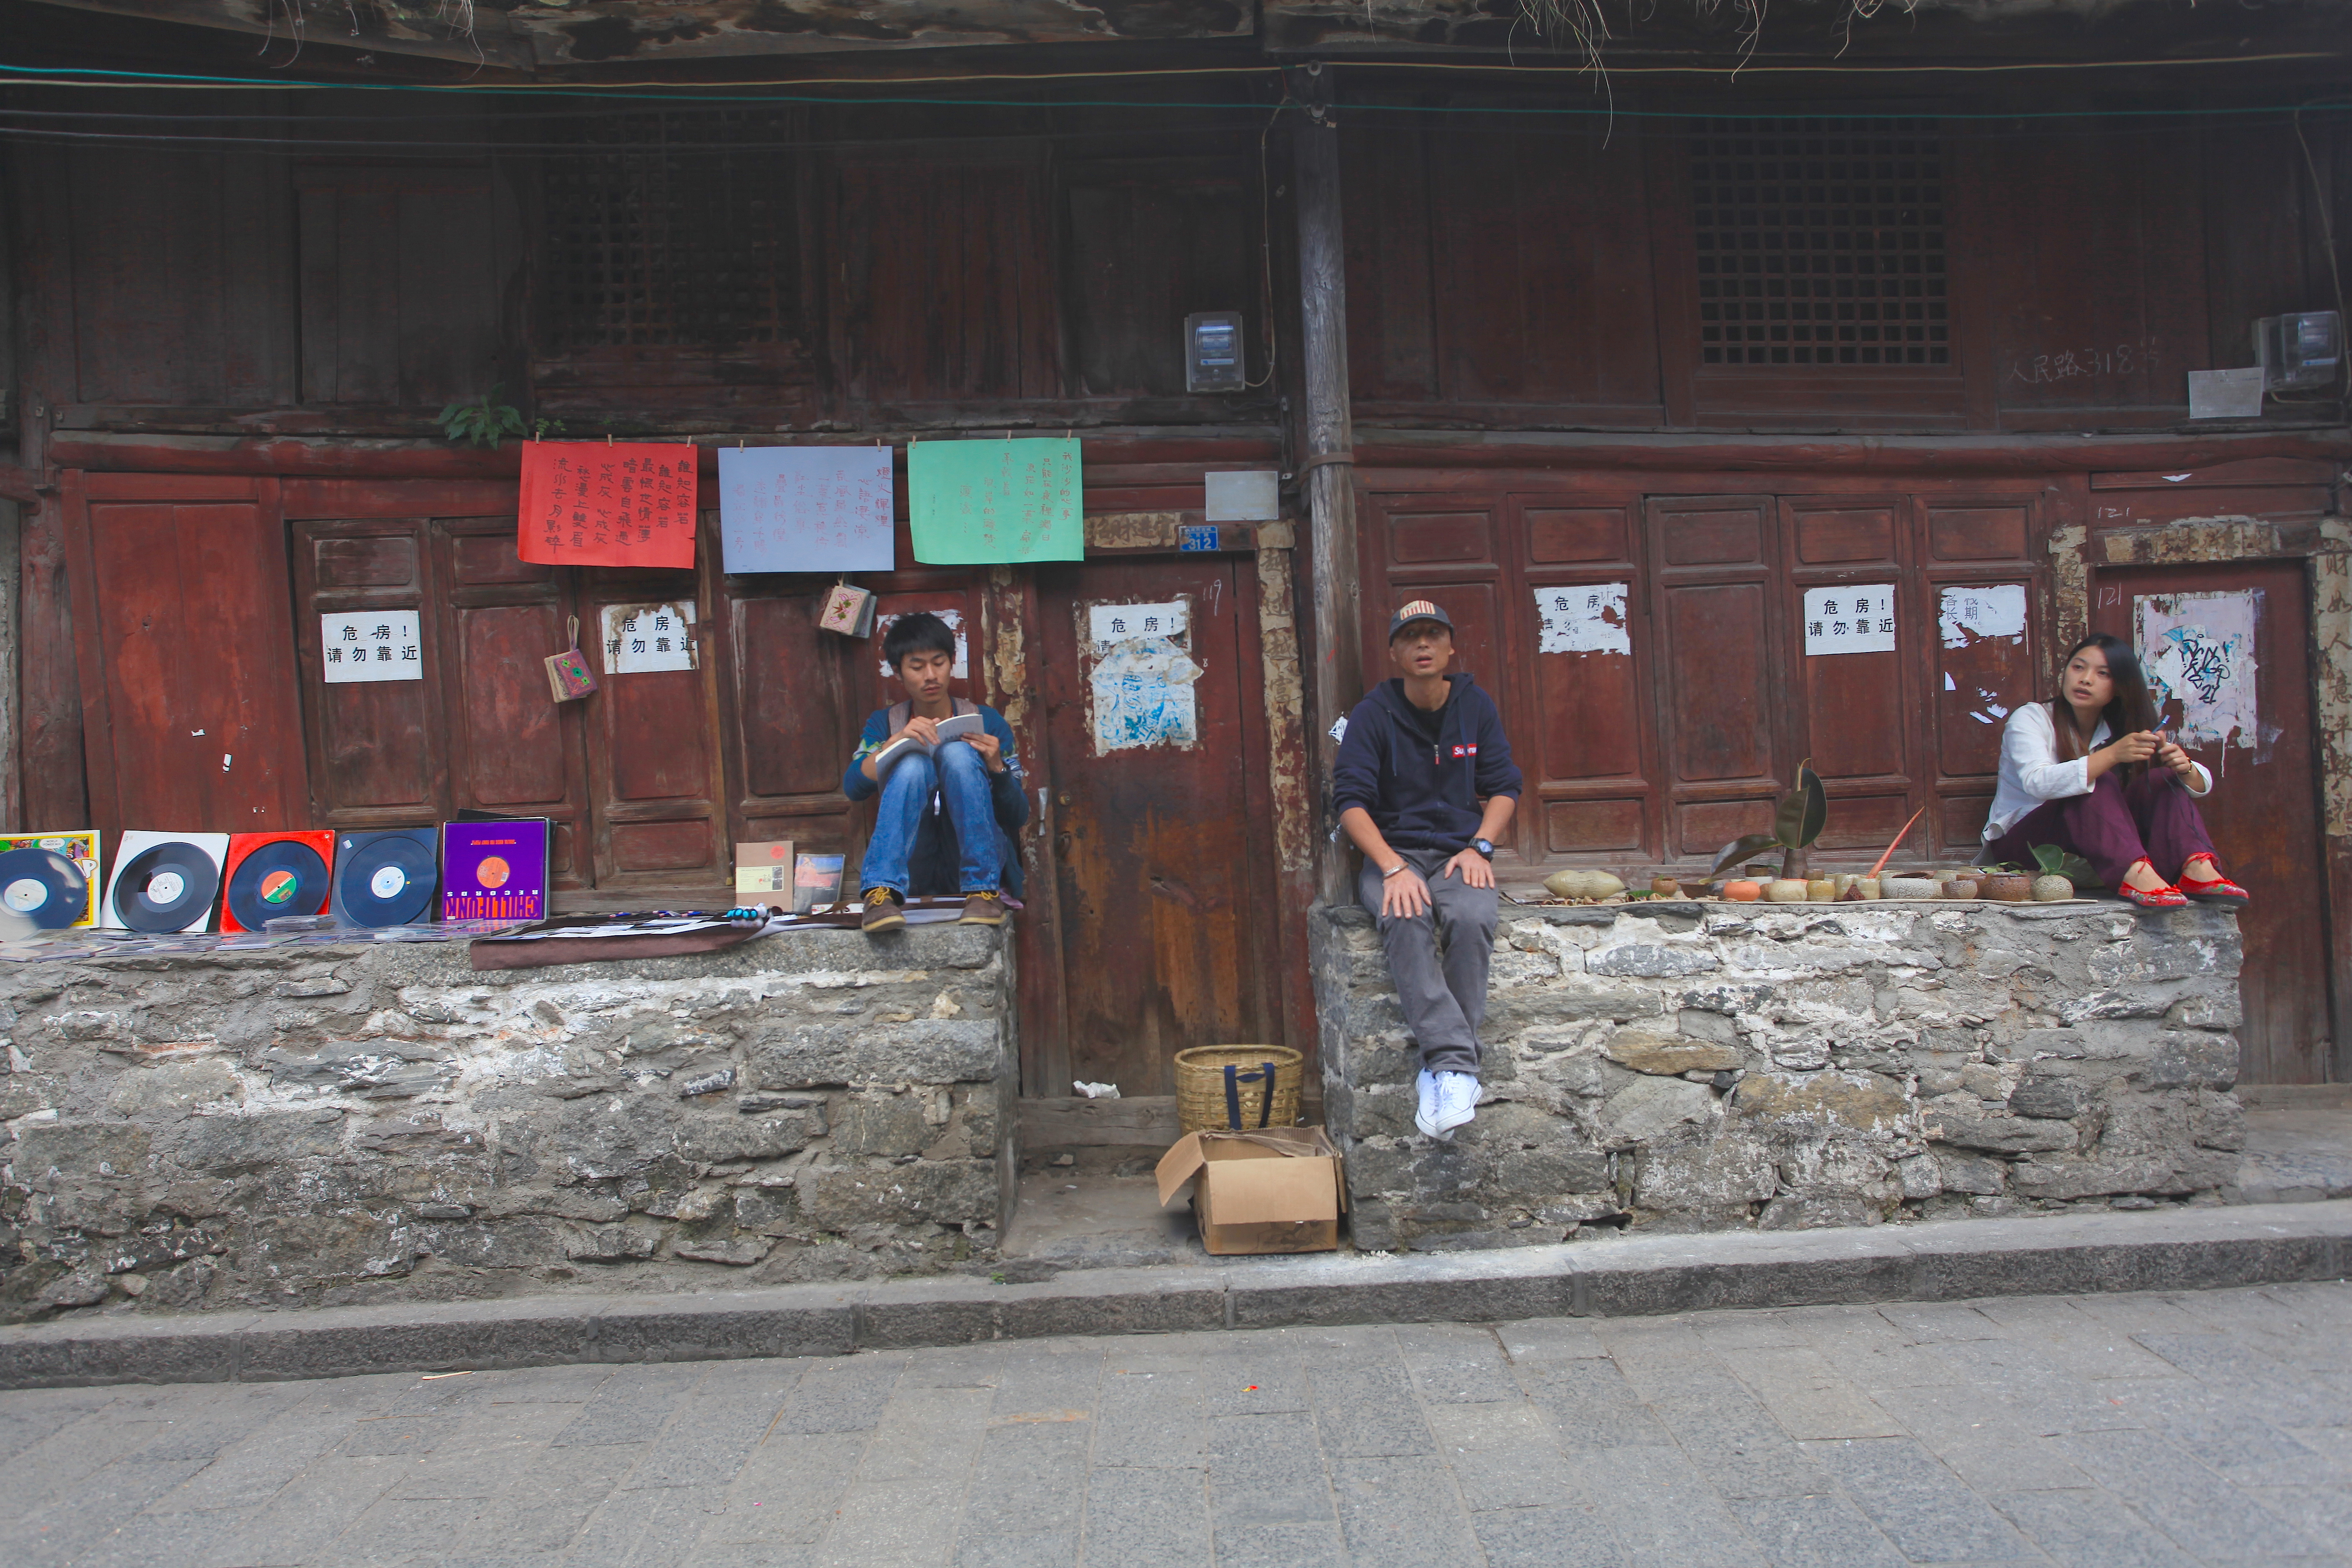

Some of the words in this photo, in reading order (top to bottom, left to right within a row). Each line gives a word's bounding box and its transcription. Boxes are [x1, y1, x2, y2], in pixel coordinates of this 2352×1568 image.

[656, 464, 673, 528] 誰知容若
[673, 460, 694, 524] 誰知容若
[875, 467, 892, 527] 燈火輝煌
[1189, 537, 1212, 549] 312
[1823, 598, 1885, 614] 危房！
[342, 624, 407, 641] 危房！
[1112, 616, 1174, 633] 危房！
[1808, 618, 1894, 636] 请勿靠近
[328, 645, 418, 663] 请勿靠近
[607, 637, 696, 655] 请勿靠近
